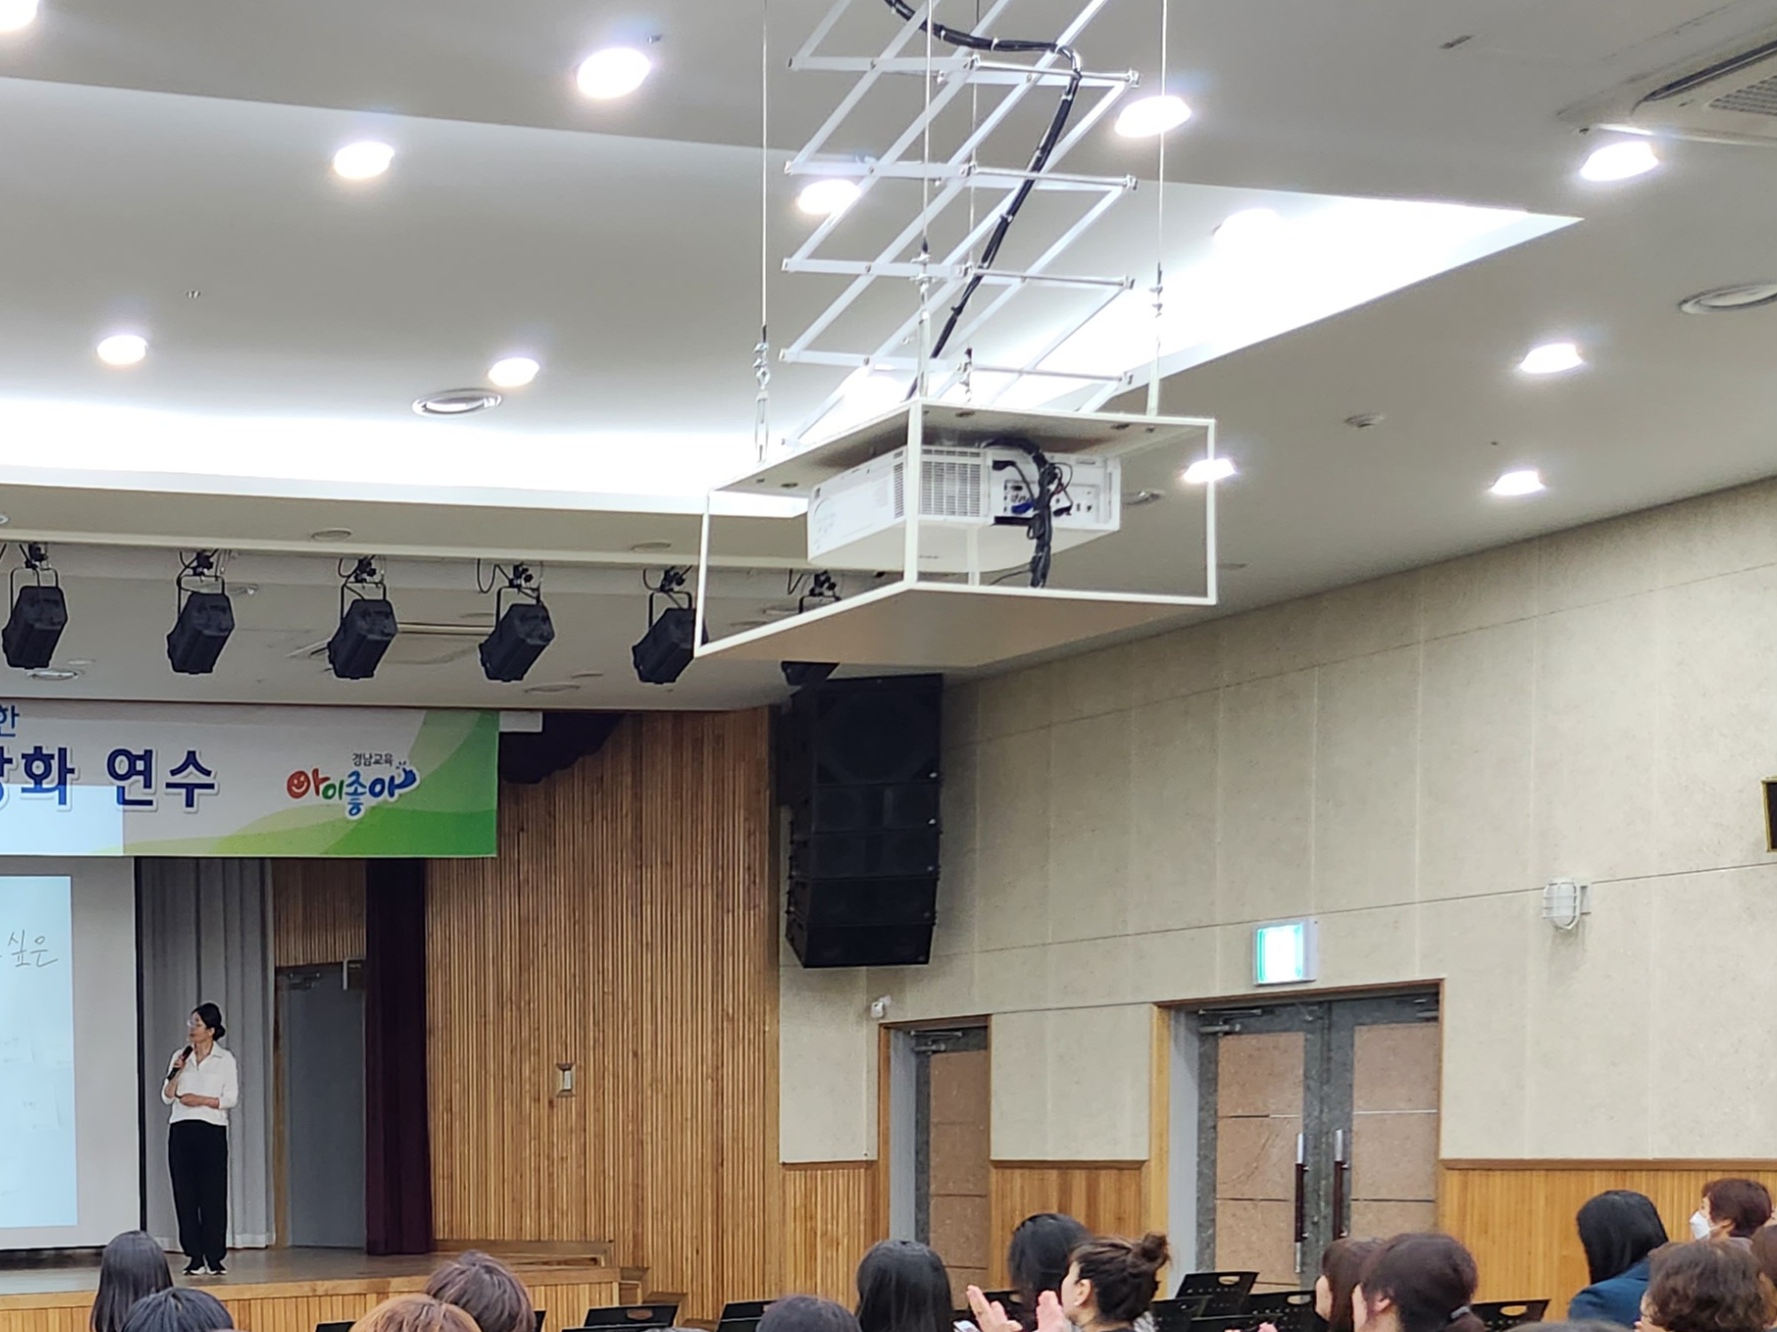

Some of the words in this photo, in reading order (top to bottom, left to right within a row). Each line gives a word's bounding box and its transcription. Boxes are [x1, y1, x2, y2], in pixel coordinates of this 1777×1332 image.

[106, 748, 215, 808] 연수
[352, 752, 394, 767] 경남교육
[286, 766, 417, 817] 아이좋아
